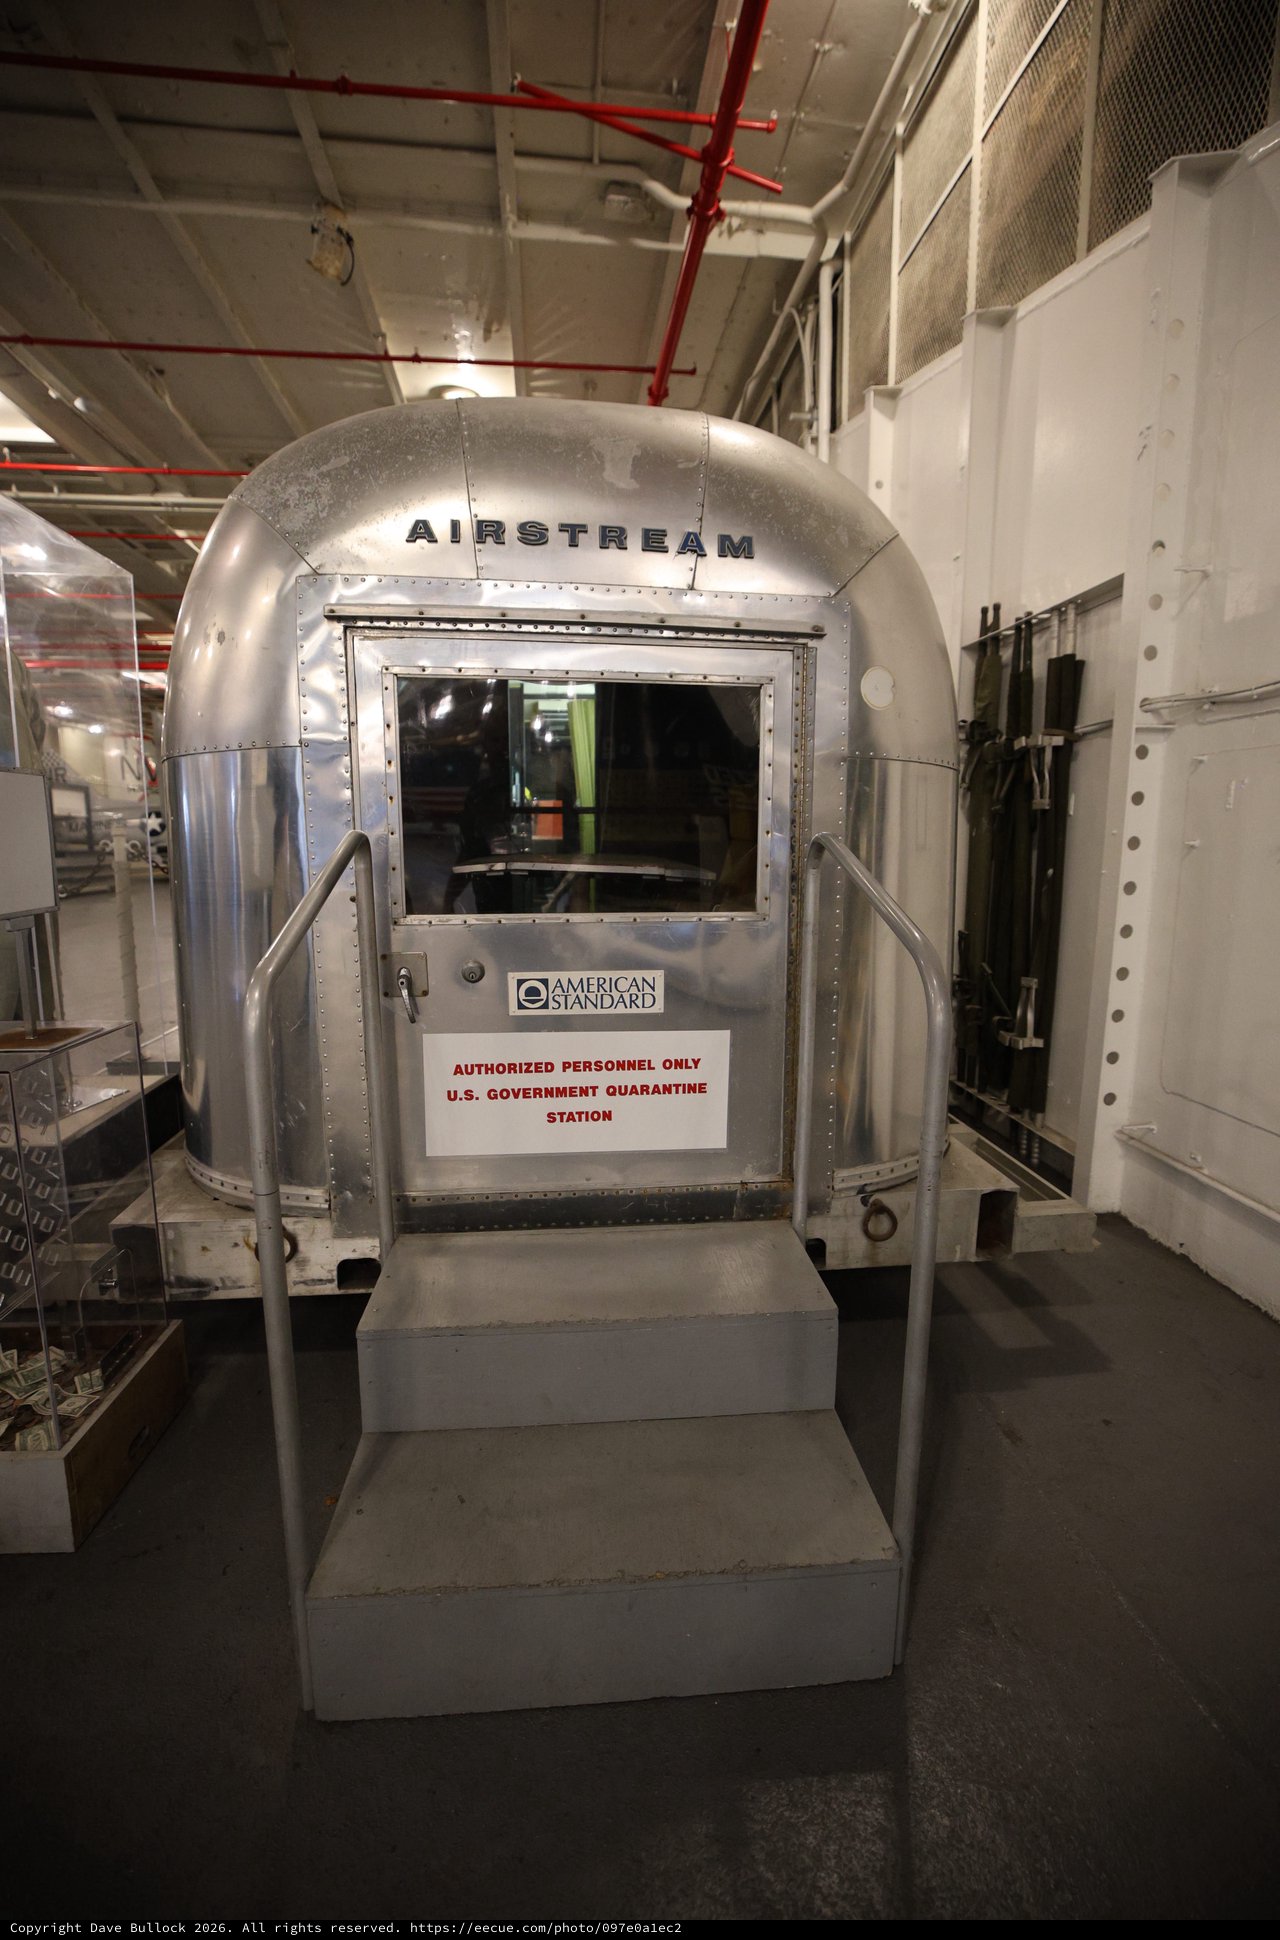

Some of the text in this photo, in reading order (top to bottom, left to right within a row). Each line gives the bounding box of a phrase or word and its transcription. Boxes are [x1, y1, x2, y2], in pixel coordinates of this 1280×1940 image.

[406, 519, 755, 559] AIRSTREAM
[551, 976, 656, 994] AMERICAN
[551, 992, 657, 1010] STANDARD
[453, 1057, 701, 1076] AUTHORIZED PERSONNEL ONLY
[447, 1082, 707, 1102] U.S. GOVERNMENT QUARANTINE
[546, 1110, 614, 1124] STATION
